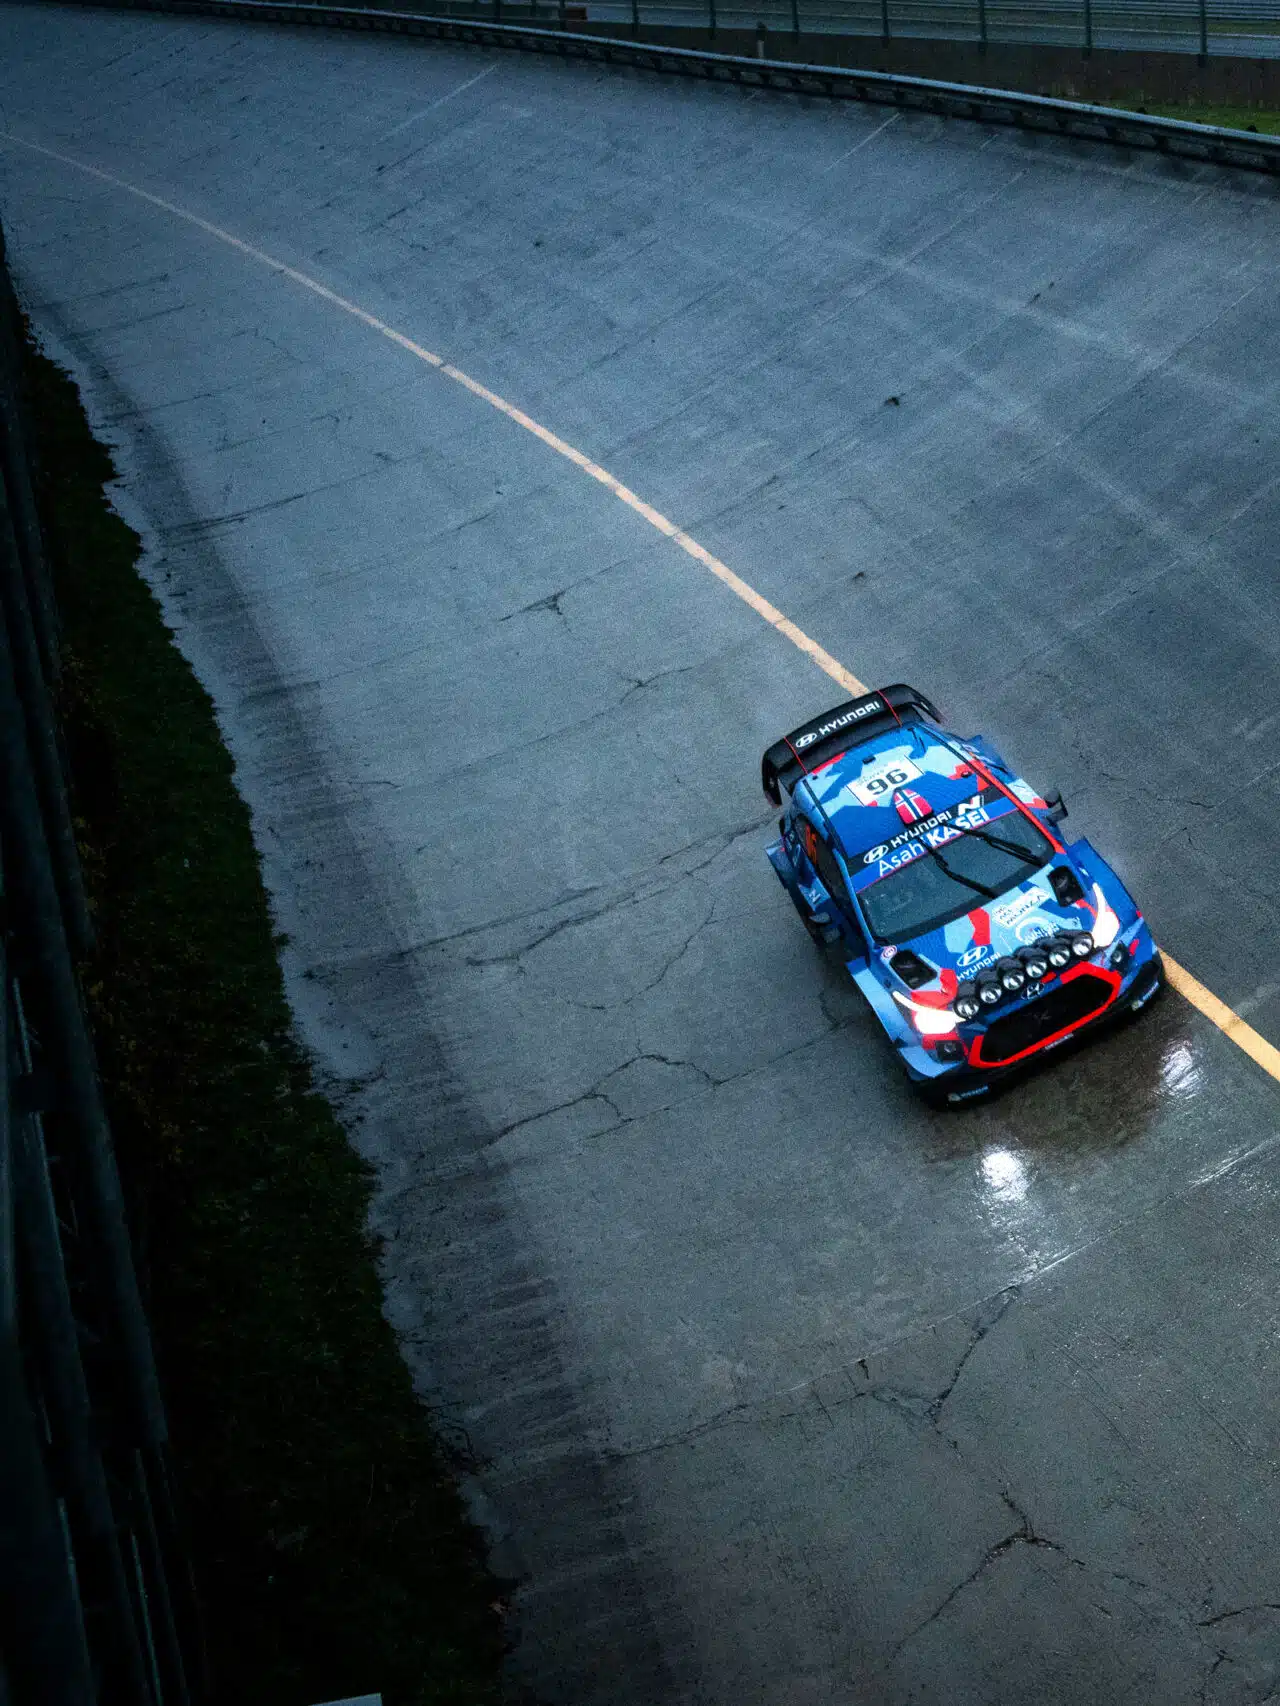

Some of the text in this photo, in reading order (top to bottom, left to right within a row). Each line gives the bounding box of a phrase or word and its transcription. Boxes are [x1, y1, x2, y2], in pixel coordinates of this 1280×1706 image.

[819, 701, 881, 736] HYUNDAI
[866, 768, 908, 796] 96
[878, 807, 990, 877] Asah KASEI
[890, 810, 953, 848] HYUNDAI
[956, 952, 1001, 981] HYUNDAI
